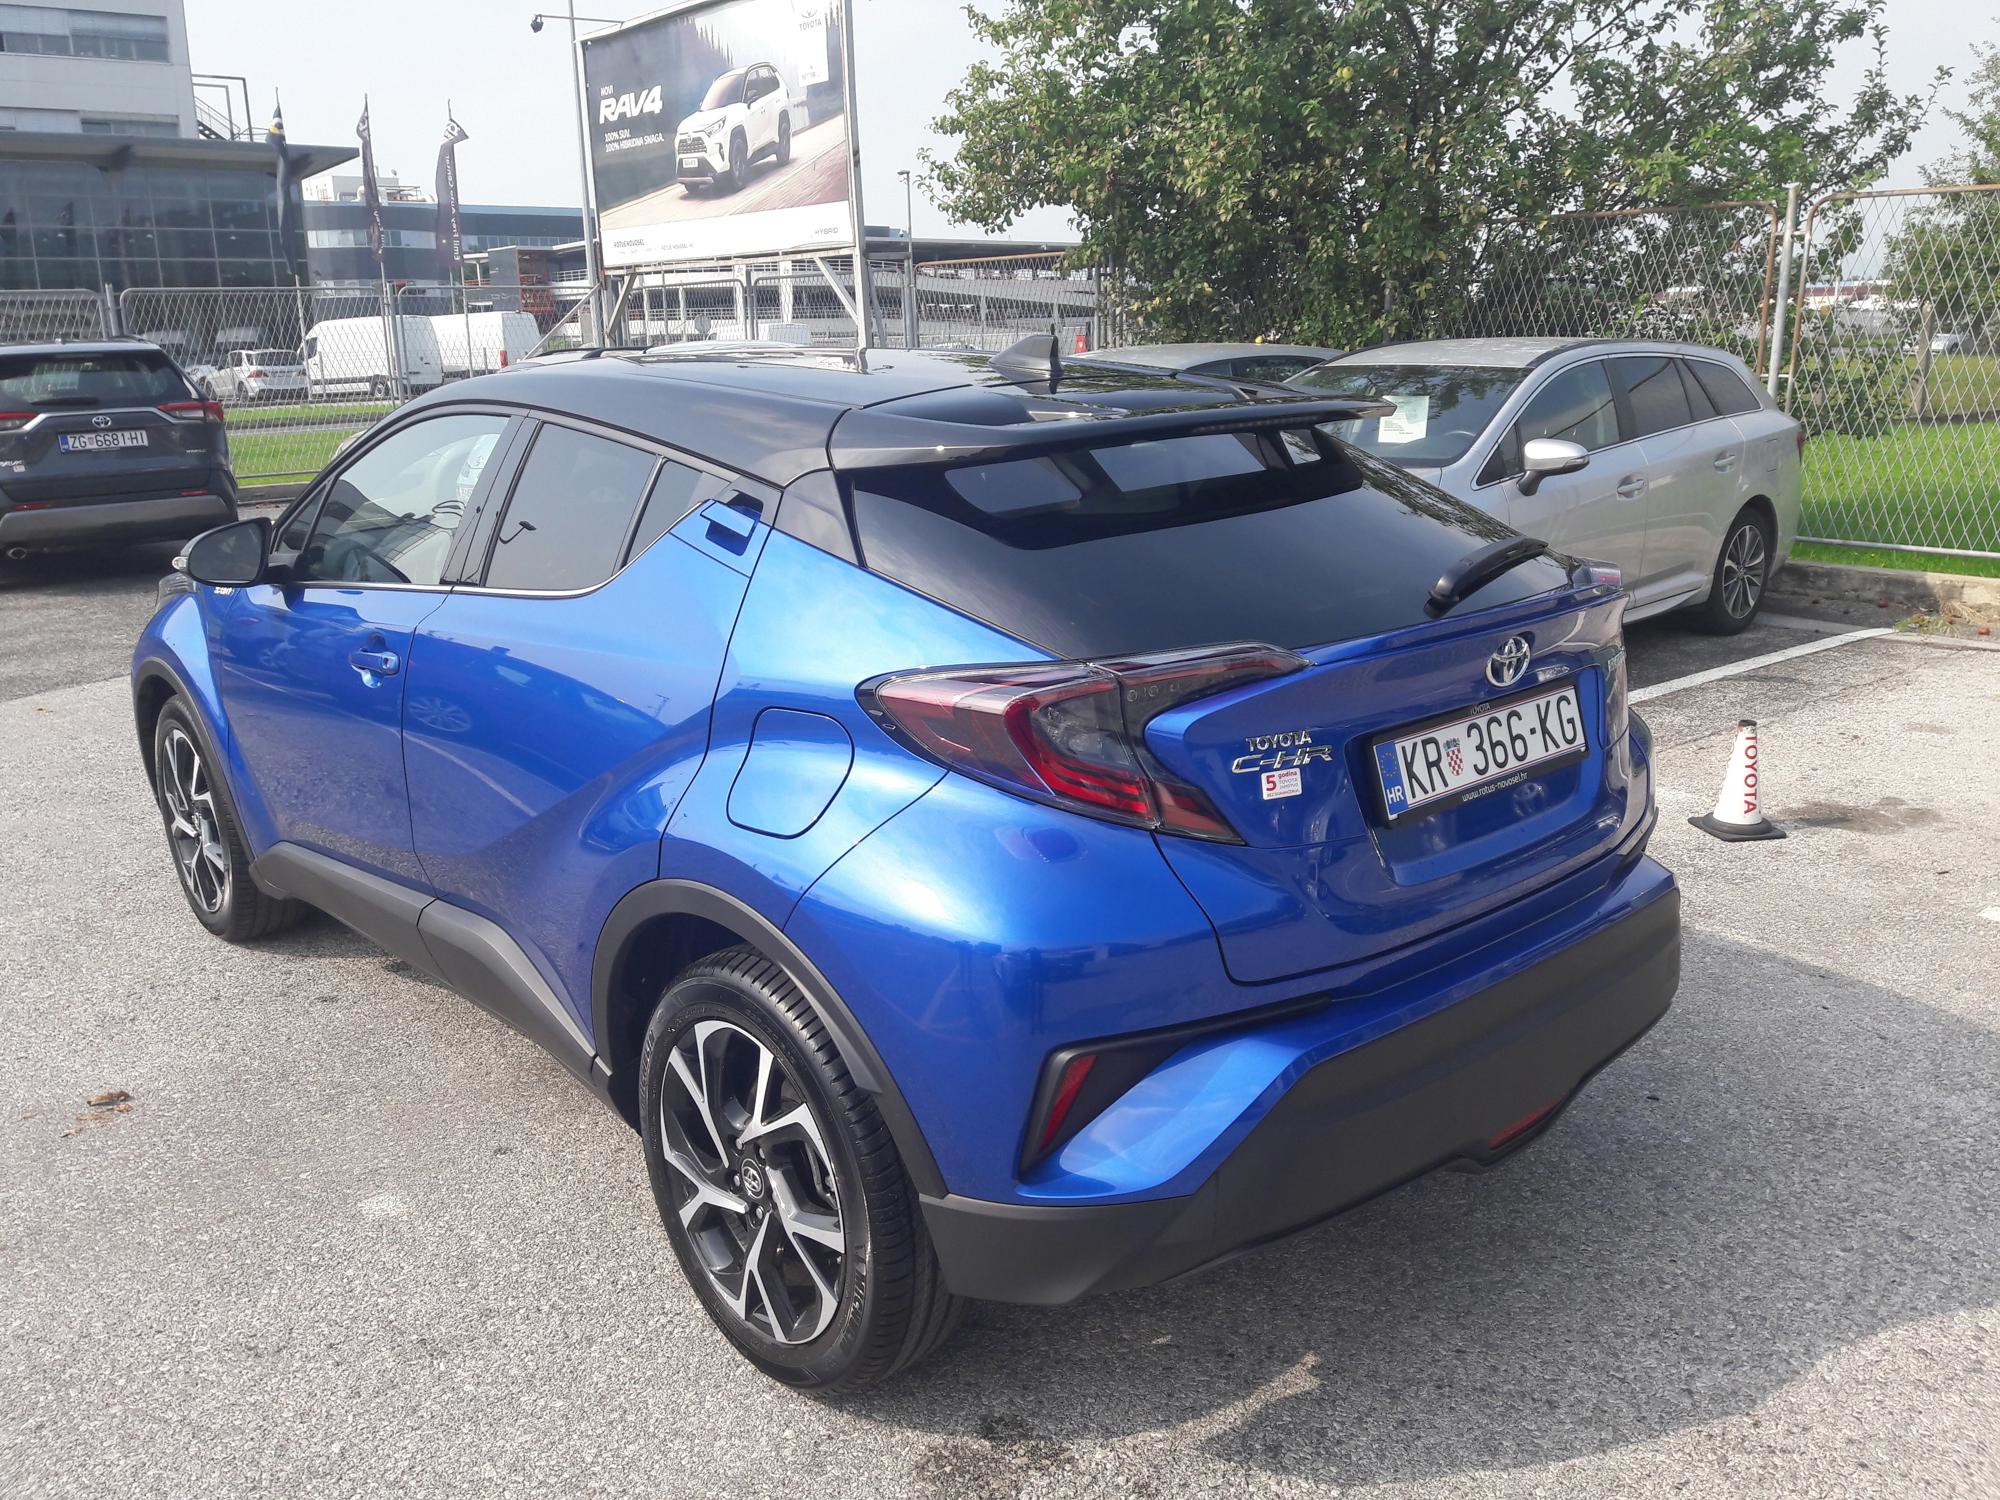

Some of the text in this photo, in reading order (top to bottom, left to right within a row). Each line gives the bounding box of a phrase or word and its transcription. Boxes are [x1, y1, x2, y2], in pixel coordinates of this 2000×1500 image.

[599, 85, 663, 125] RAV4
[600, 85, 613, 96] NOVI
[69, 435, 87, 449] ZG
[1245, 730, 1312, 752] TOYOTA
[1386, 695, 1578, 803] HR KR 366-KG
[1231, 744, 1333, 774] C-HR
[1266, 771, 1298, 791] 5 godina
[1462, 771, 1528, 802] www.rotus-novosel.hr
[1744, 735, 1758, 814] TOYOTA
